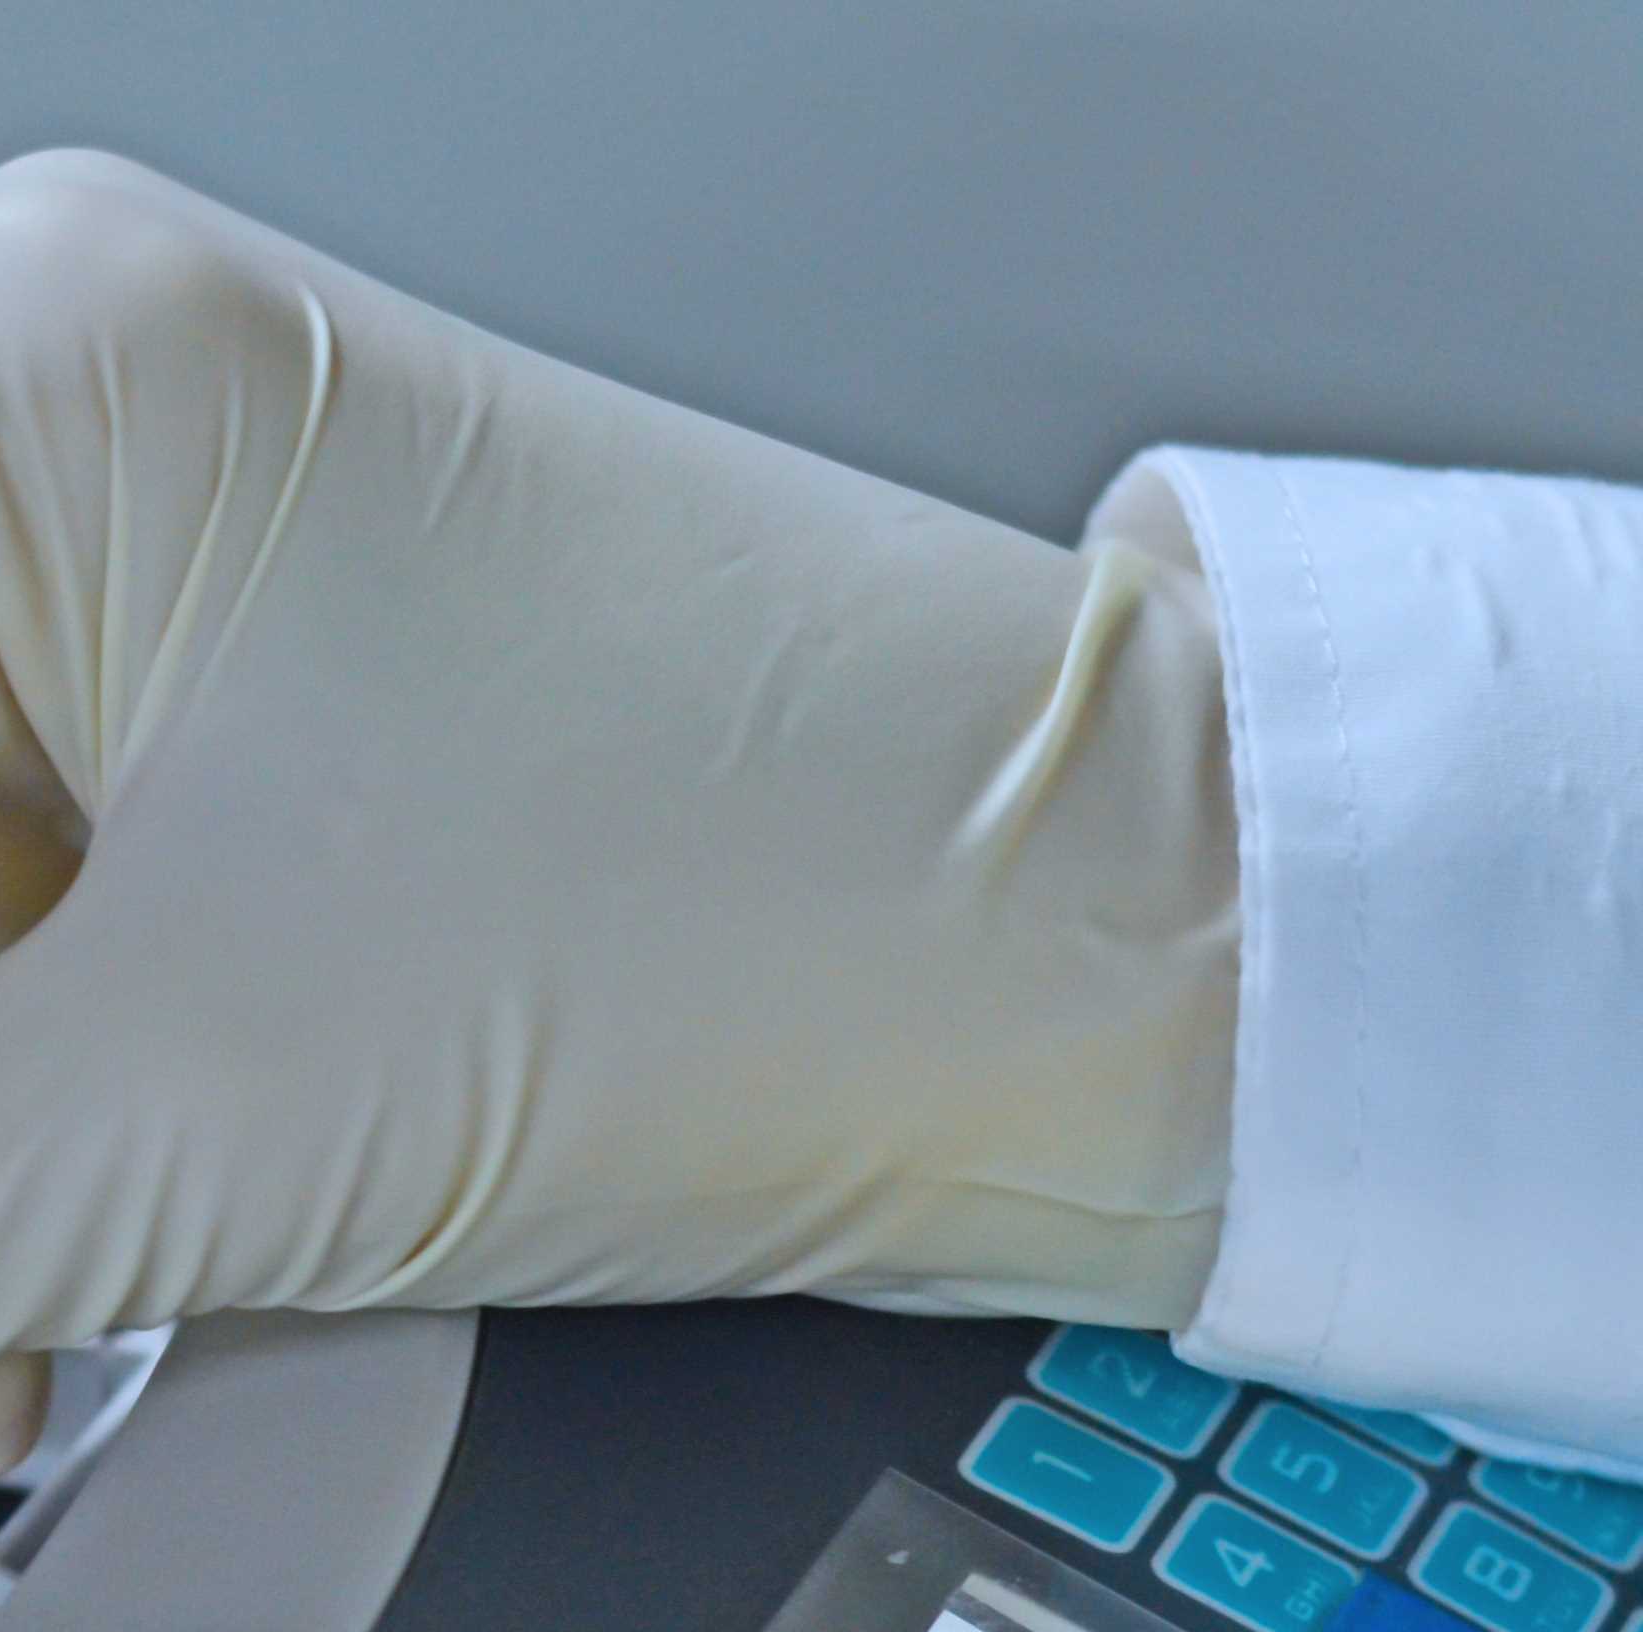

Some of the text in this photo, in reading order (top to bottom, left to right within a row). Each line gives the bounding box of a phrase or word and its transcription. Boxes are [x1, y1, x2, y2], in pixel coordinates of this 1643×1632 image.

[1087, 1347, 1159, 1399] 2
[1032, 1451, 1094, 1482] 1
[1271, 1440, 1340, 1494] 5
[1214, 1537, 1275, 1588] 4
[1463, 1545, 1533, 1602] 8
